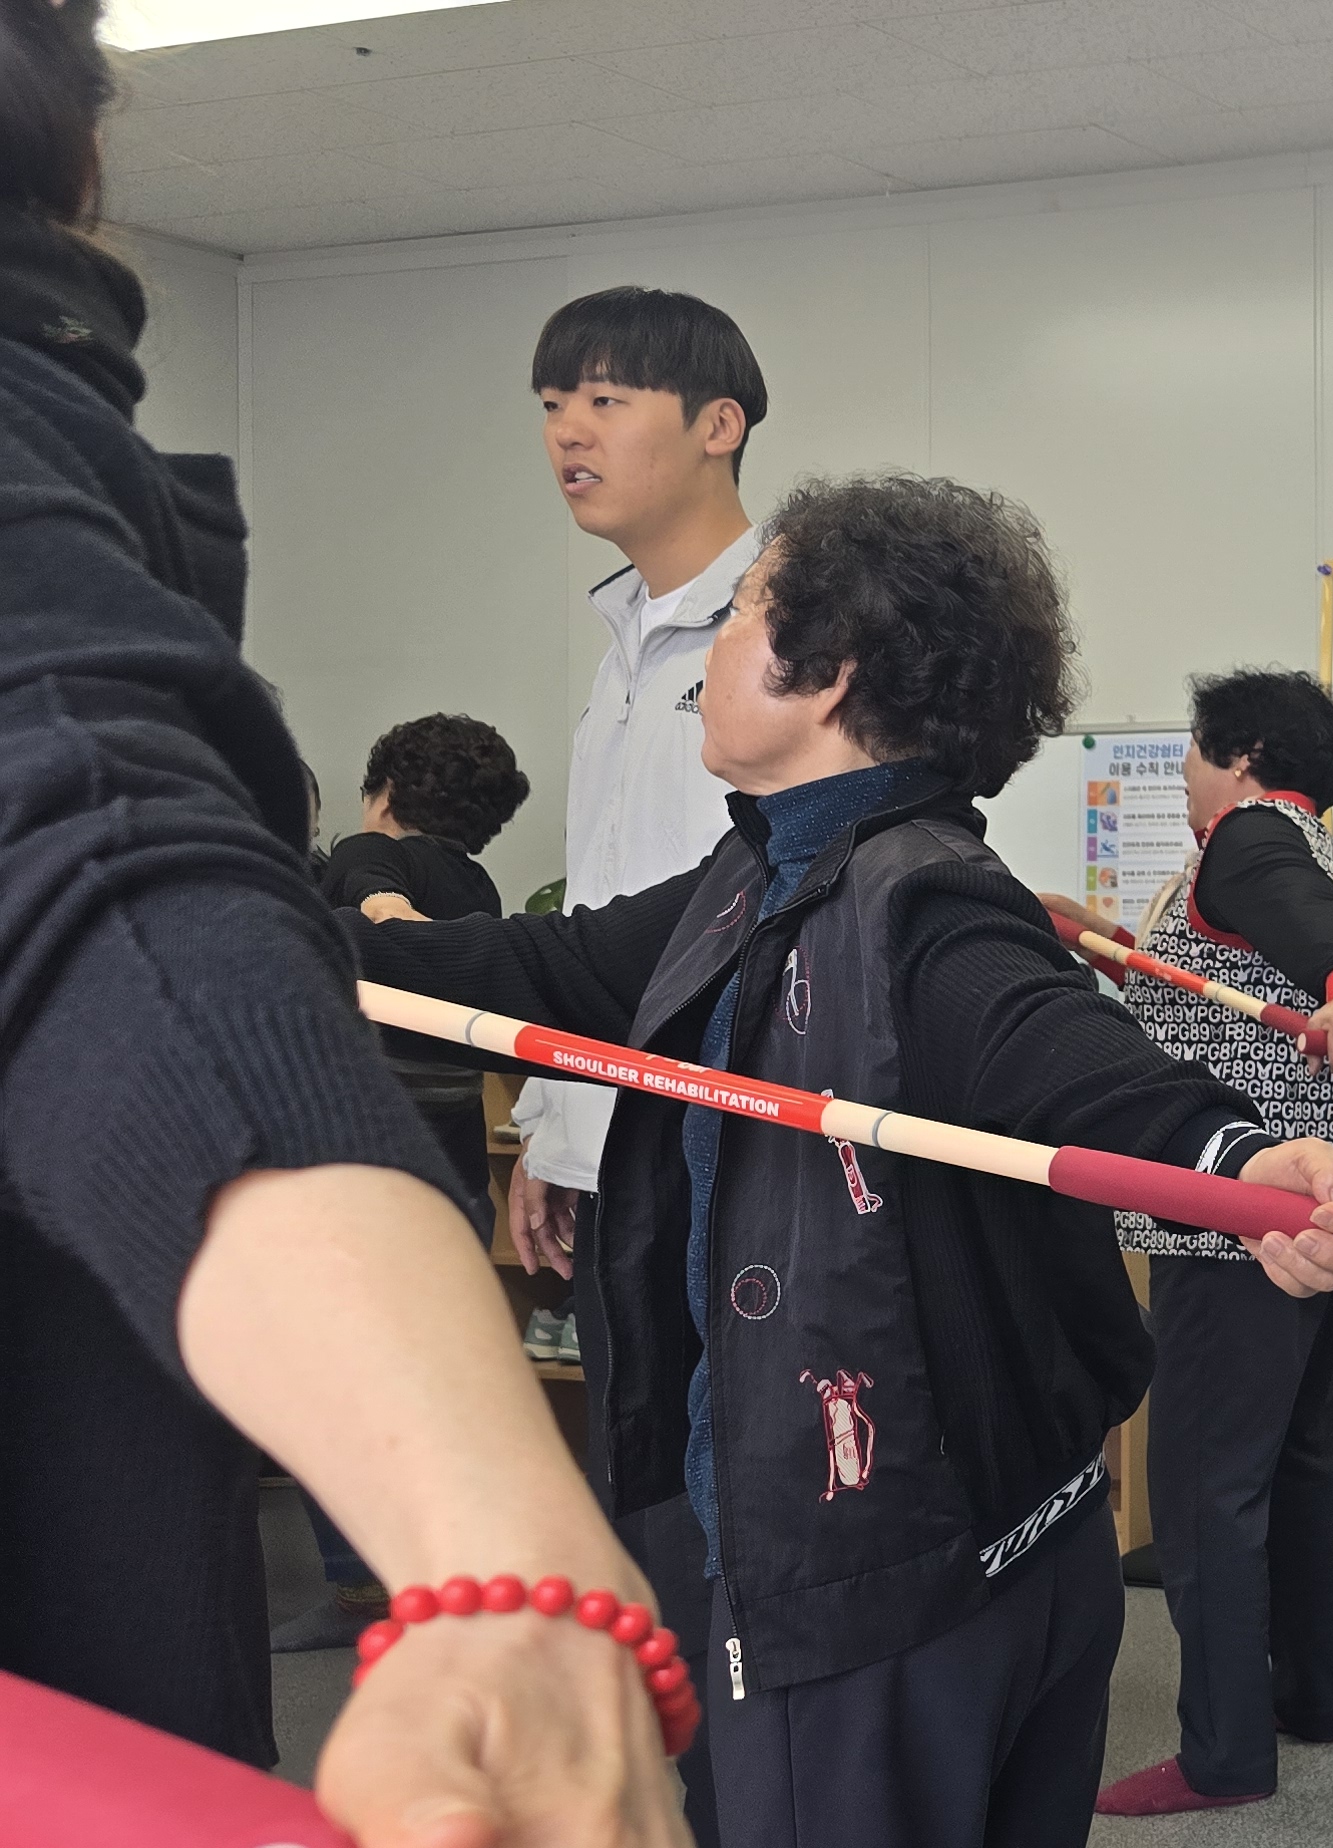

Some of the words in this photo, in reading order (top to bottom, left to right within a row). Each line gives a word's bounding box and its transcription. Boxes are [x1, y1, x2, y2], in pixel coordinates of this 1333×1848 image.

[1112, 744, 1184, 759] 인지건강쉼터
[1109, 763, 1132, 777] 이용
[1136, 762, 1159, 777] 수칙
[1144, 1005, 1184, 1024] PG89
[1168, 1022, 1210, 1041] PG89
[1237, 1041, 1288, 1062] PG89
[552, 1050, 640, 1083] SHOULDER
[643, 1072, 780, 1118] REHABILITATION
[1269, 1100, 1312, 1120] PG89
[1113, 1210, 1145, 1229] PG89
[1132, 1229, 1165, 1249] PG89
